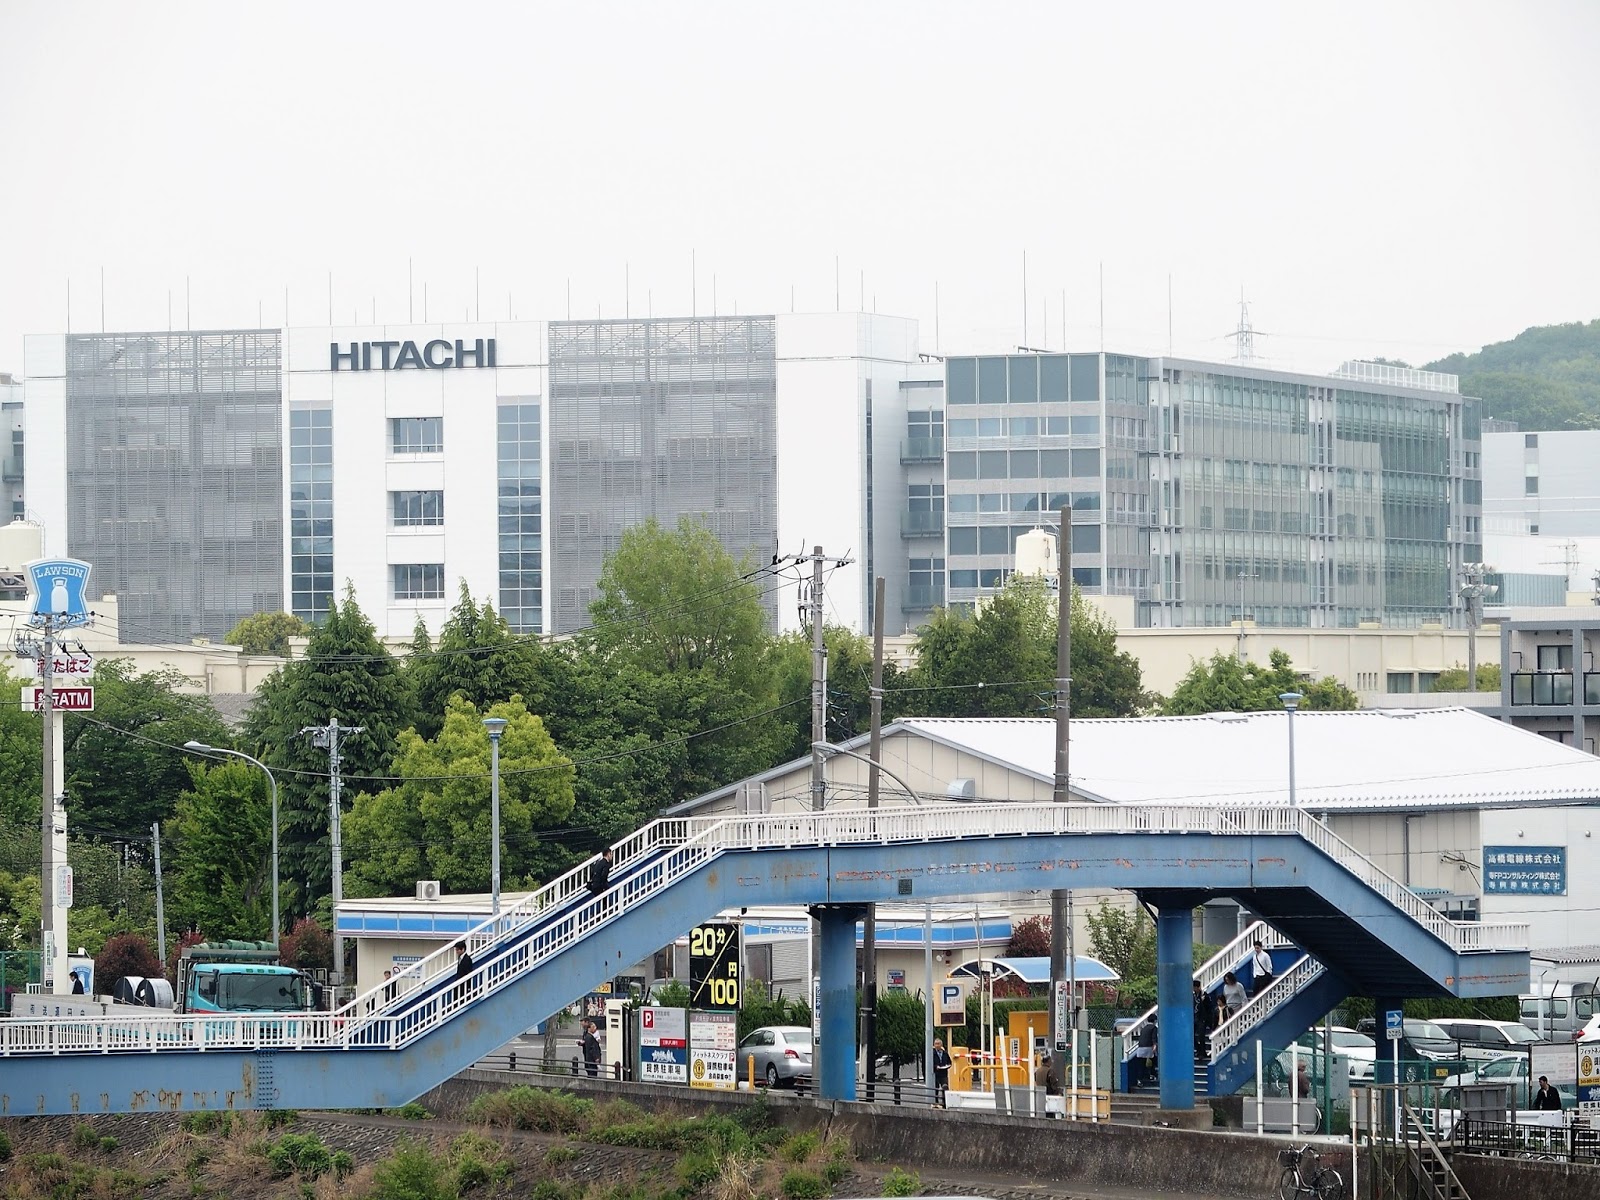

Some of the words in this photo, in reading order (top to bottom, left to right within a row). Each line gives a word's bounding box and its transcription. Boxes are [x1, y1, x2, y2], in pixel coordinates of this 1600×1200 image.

[330, 338, 496, 371] HITACHI
[35, 566, 84, 579] LAWSON
[728, 961, 738, 977] 円
[708, 978, 738, 1005] 100
[943, 986, 960, 1004] P
